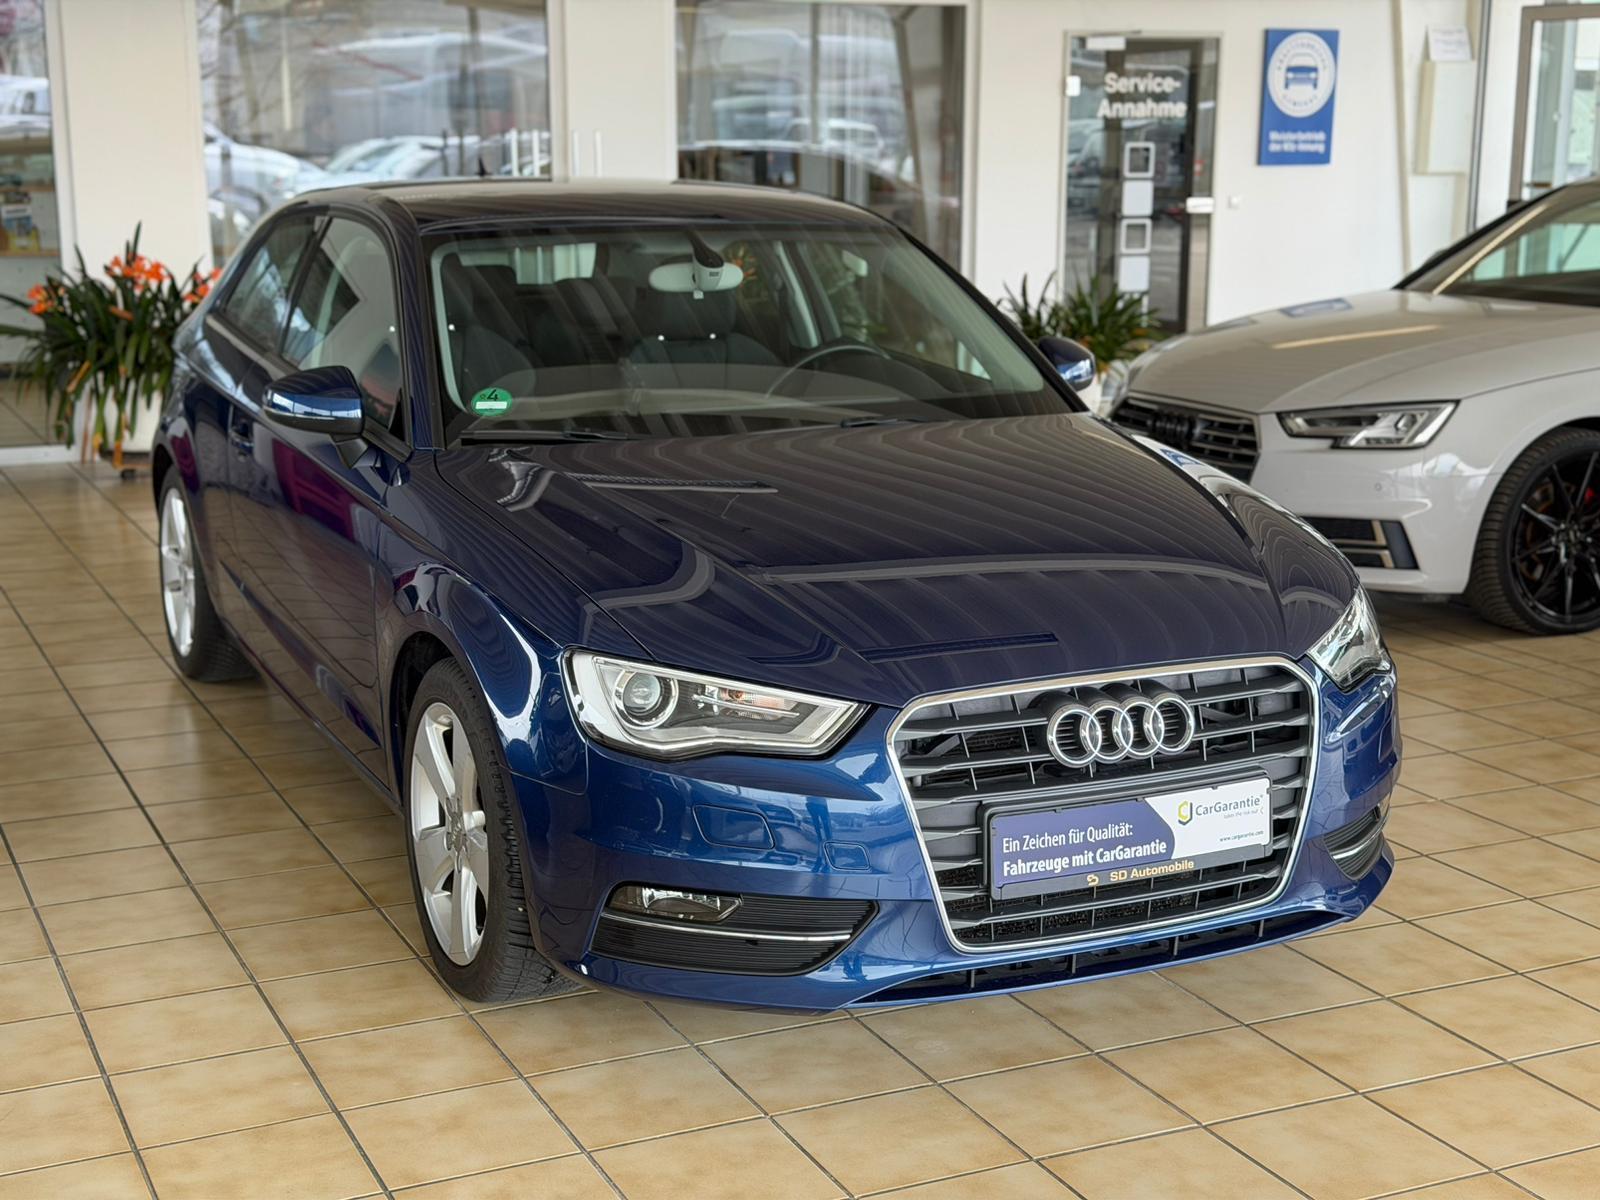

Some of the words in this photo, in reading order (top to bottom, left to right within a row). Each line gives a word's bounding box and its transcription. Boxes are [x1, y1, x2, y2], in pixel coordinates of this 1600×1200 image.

[1104, 72, 1181, 93] Service-
[1096, 98, 1187, 118] Annahme
[487, 389, 498, 401] 4
[1003, 837, 1020, 853] Ein
[1022, 832, 1066, 851] Zeichen
[1068, 828, 1085, 844] für
[1087, 822, 1133, 842] Qualität:
[1003, 858, 1070, 876] Fahrzeuge
[1072, 850, 1094, 867] mit
[1096, 839, 1167, 863] CarGarantie
[1110, 870, 1127, 881] SD
[1130, 859, 1194, 879] Automobile
